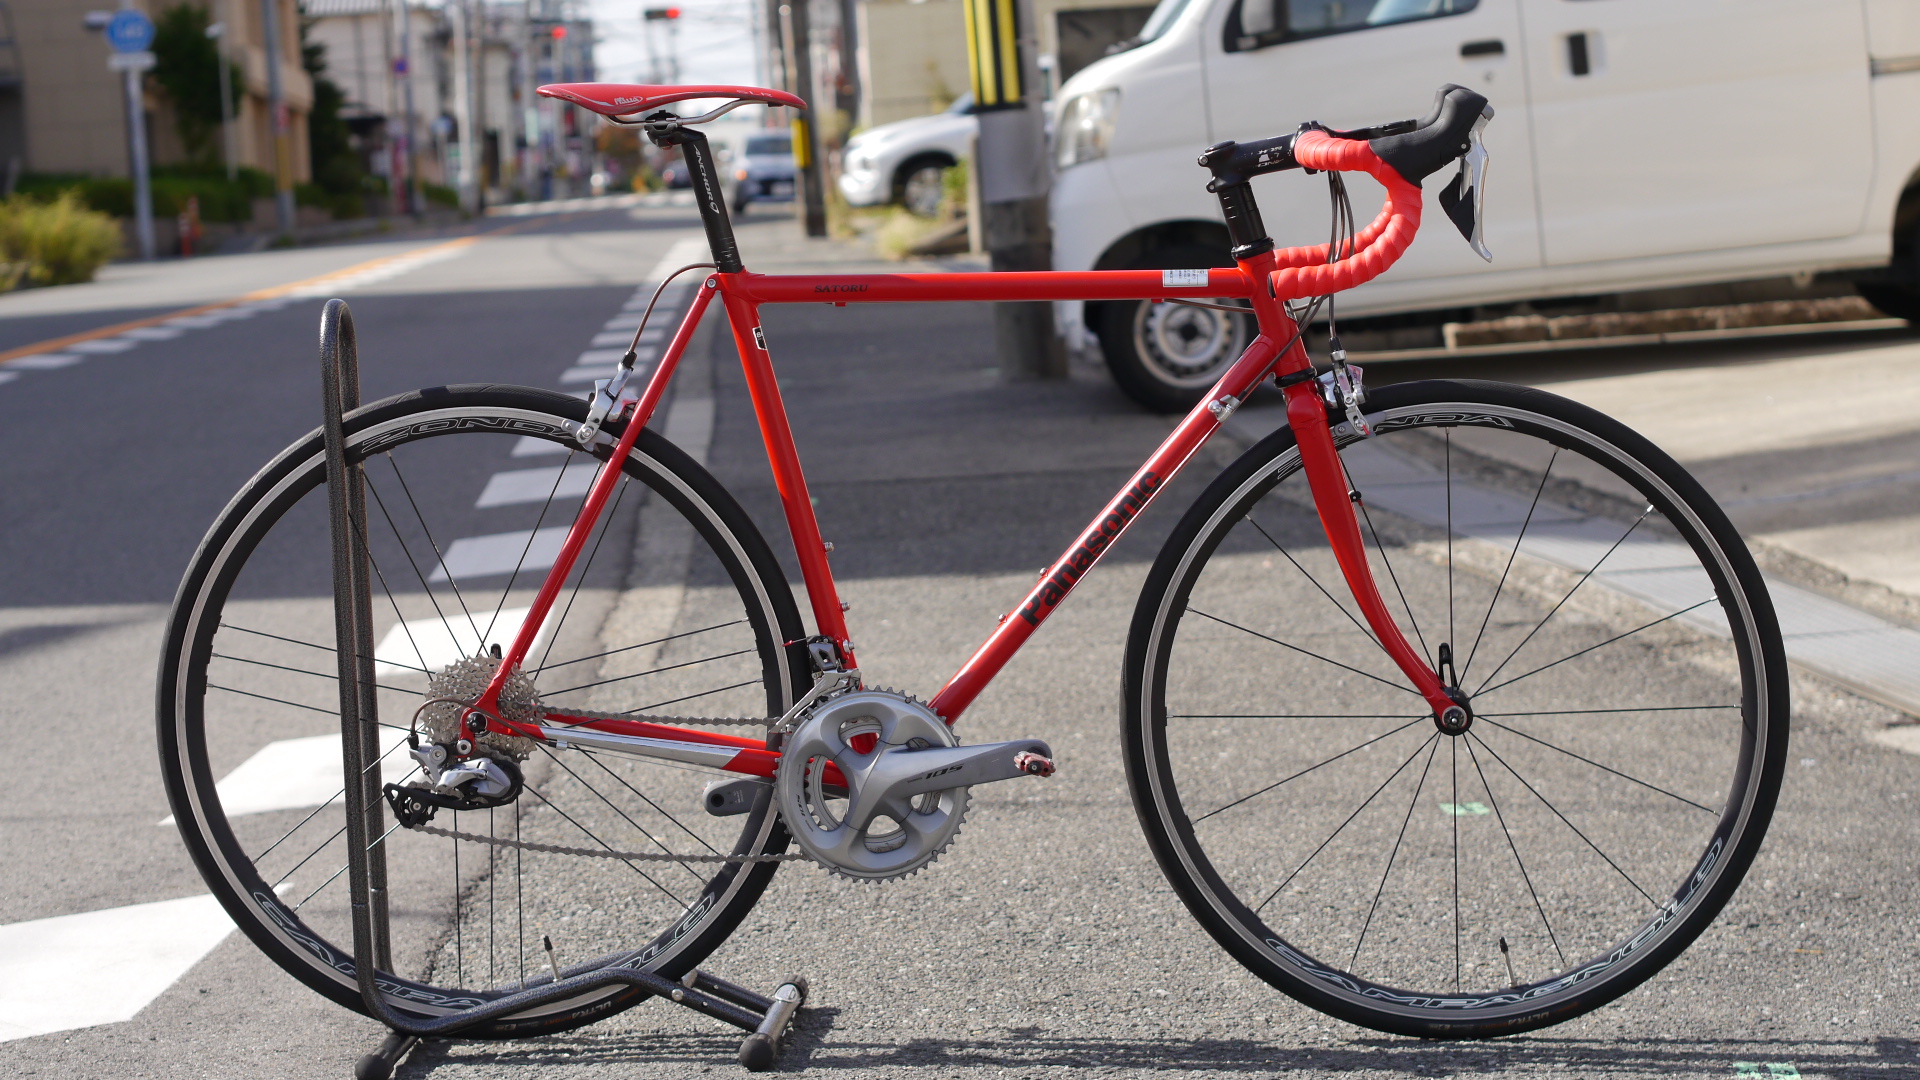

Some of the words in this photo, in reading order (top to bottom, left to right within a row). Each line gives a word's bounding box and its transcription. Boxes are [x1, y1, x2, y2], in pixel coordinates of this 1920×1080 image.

[693, 143, 714, 201] ANCHOR
[814, 284, 869, 293] SATORU
[1018, 471, 1162, 627] Panasonic
[925, 763, 965, 780] 105
[572, 1000, 612, 1019] ULTRA
[1508, 1011, 1550, 1026] ULTRA
